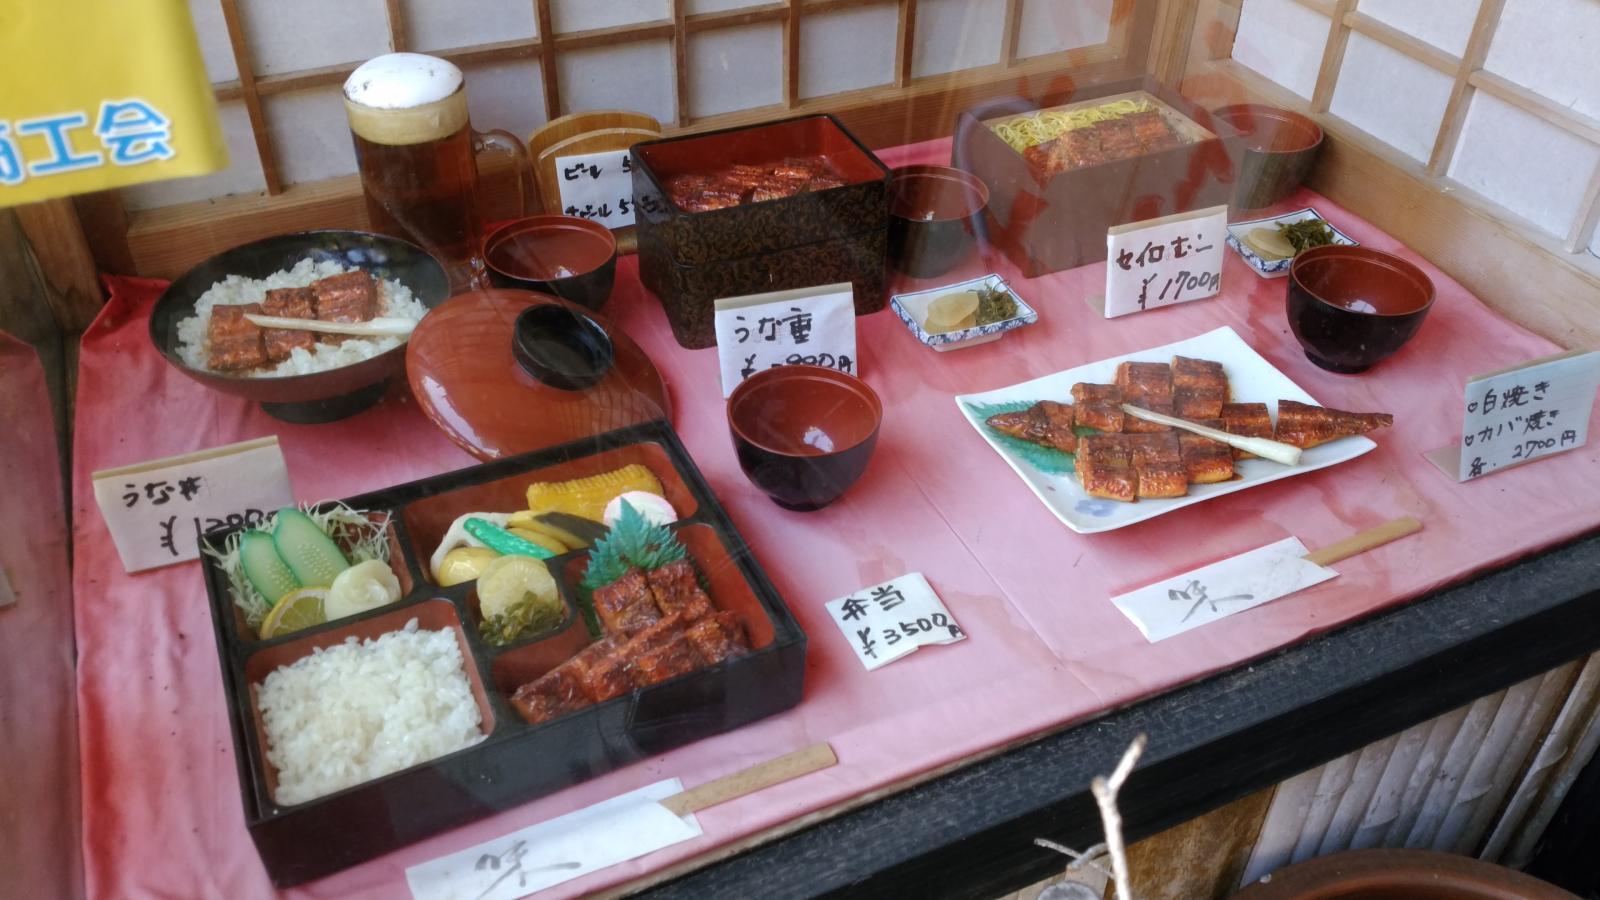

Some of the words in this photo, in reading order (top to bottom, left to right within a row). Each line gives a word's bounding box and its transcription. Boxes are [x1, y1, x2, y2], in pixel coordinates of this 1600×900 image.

[734, 307, 813, 345] うな重
[1511, 429, 1577, 459] 2700円
[841, 585, 905, 621] 弁当
